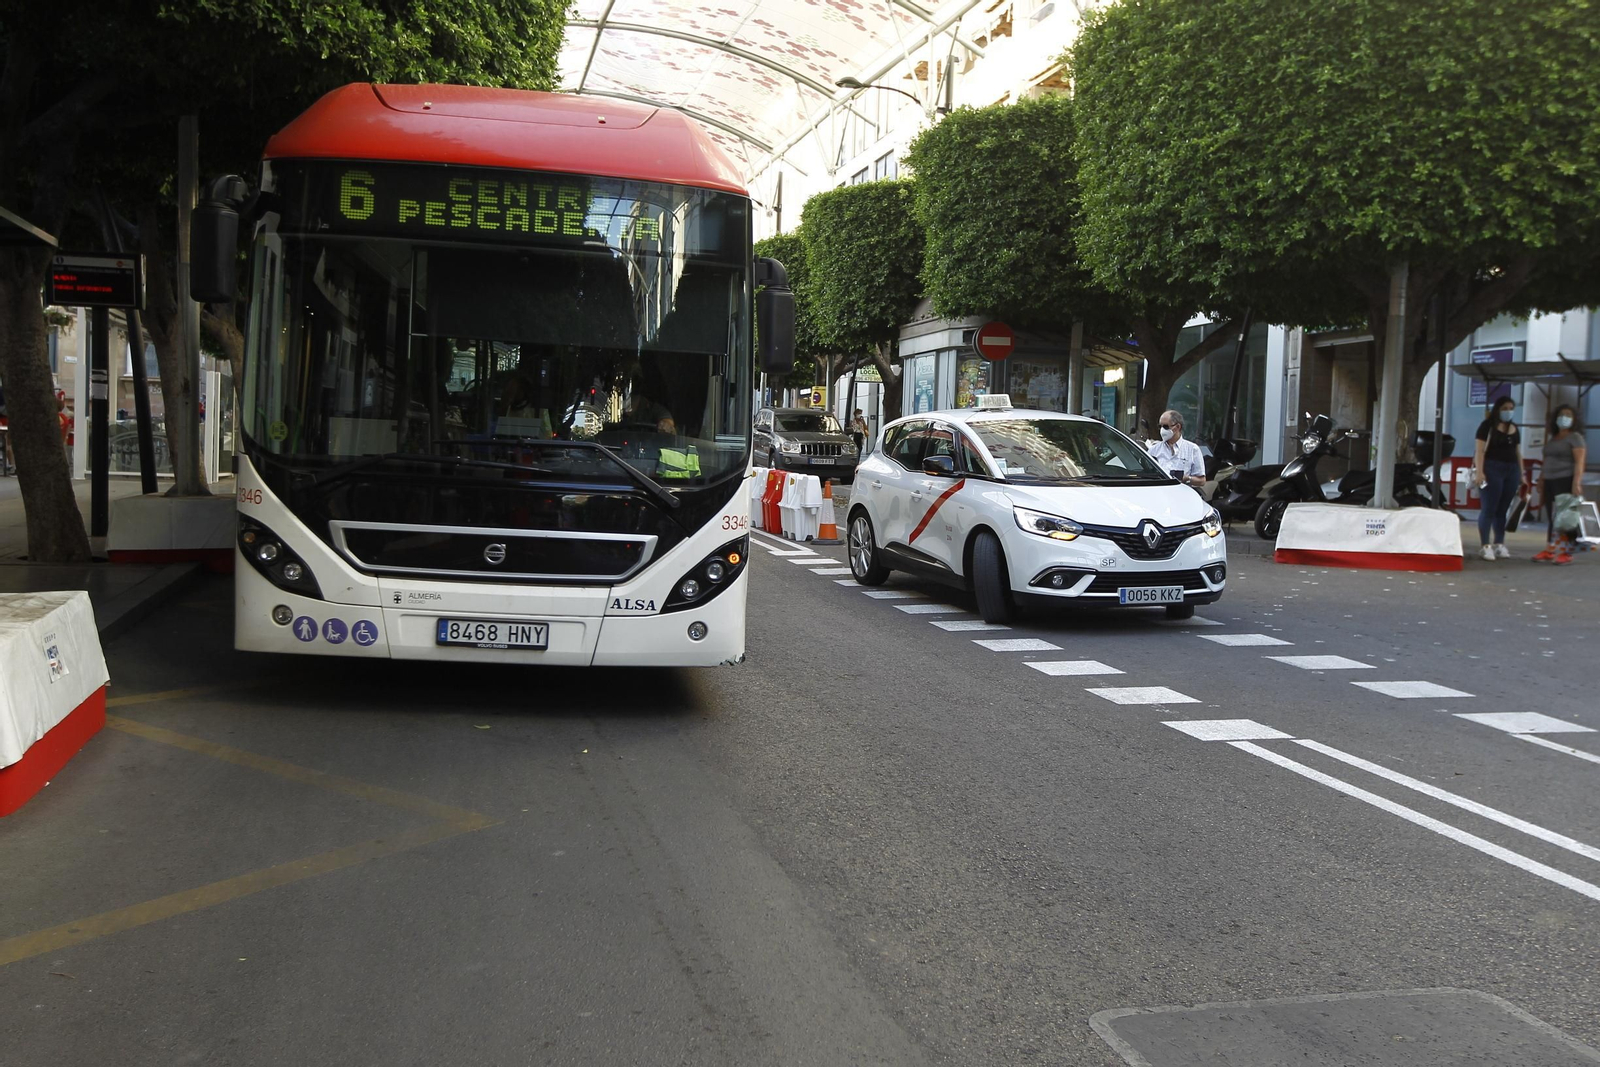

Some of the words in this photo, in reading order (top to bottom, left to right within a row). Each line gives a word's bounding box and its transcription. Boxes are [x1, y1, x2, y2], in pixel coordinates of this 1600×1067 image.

[339, 169, 375, 221] 6
[721, 514, 749, 531] 3346
[1102, 558, 1115, 567] SP
[408, 591, 442, 600] ALMERÍA
[1127, 588, 1157, 602] 0056
[1160, 587, 1182, 601] KKZ
[609, 597, 658, 612] ALSA
[450, 622, 498, 641] 8468
[508, 625, 544, 644] HNY
